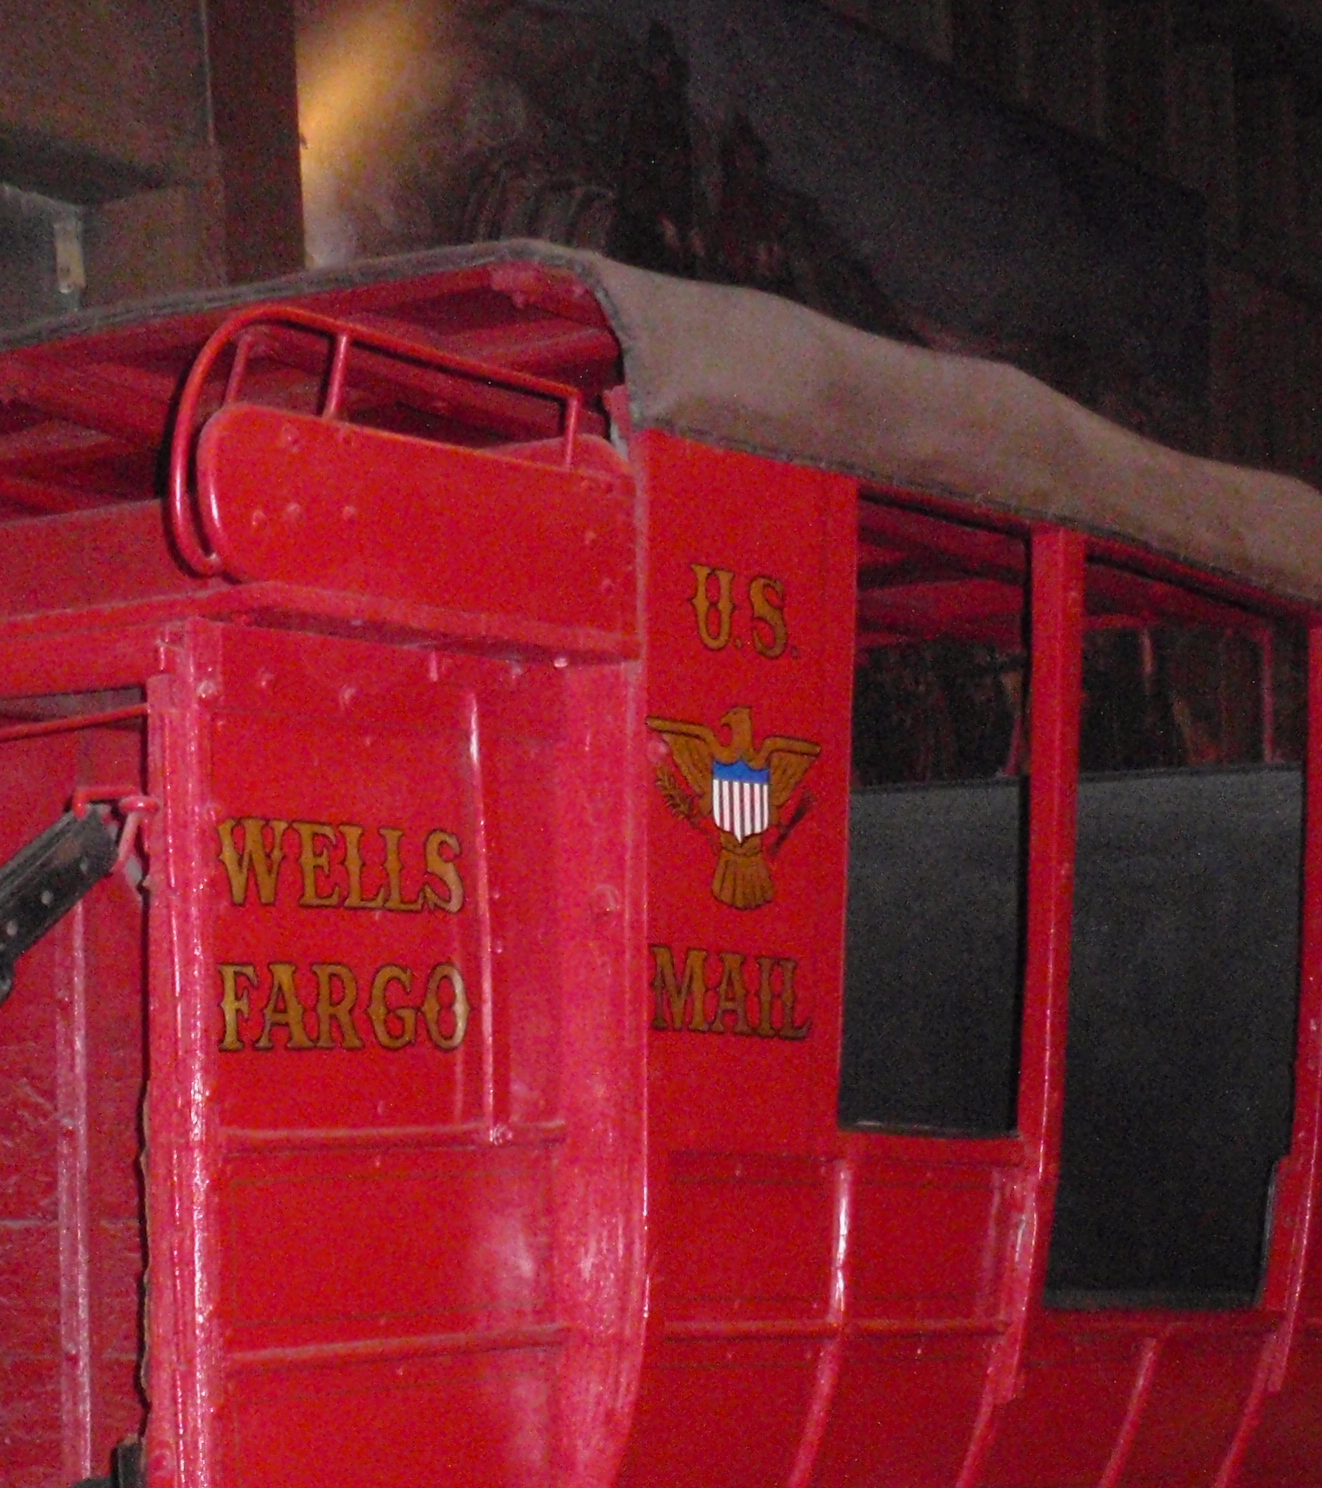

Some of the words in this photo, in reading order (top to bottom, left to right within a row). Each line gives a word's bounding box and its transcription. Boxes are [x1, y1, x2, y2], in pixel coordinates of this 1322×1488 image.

[217, 816, 465, 914] WELLS
[217, 961, 473, 1053] FARGO
[648, 943, 813, 1041] MAIL
